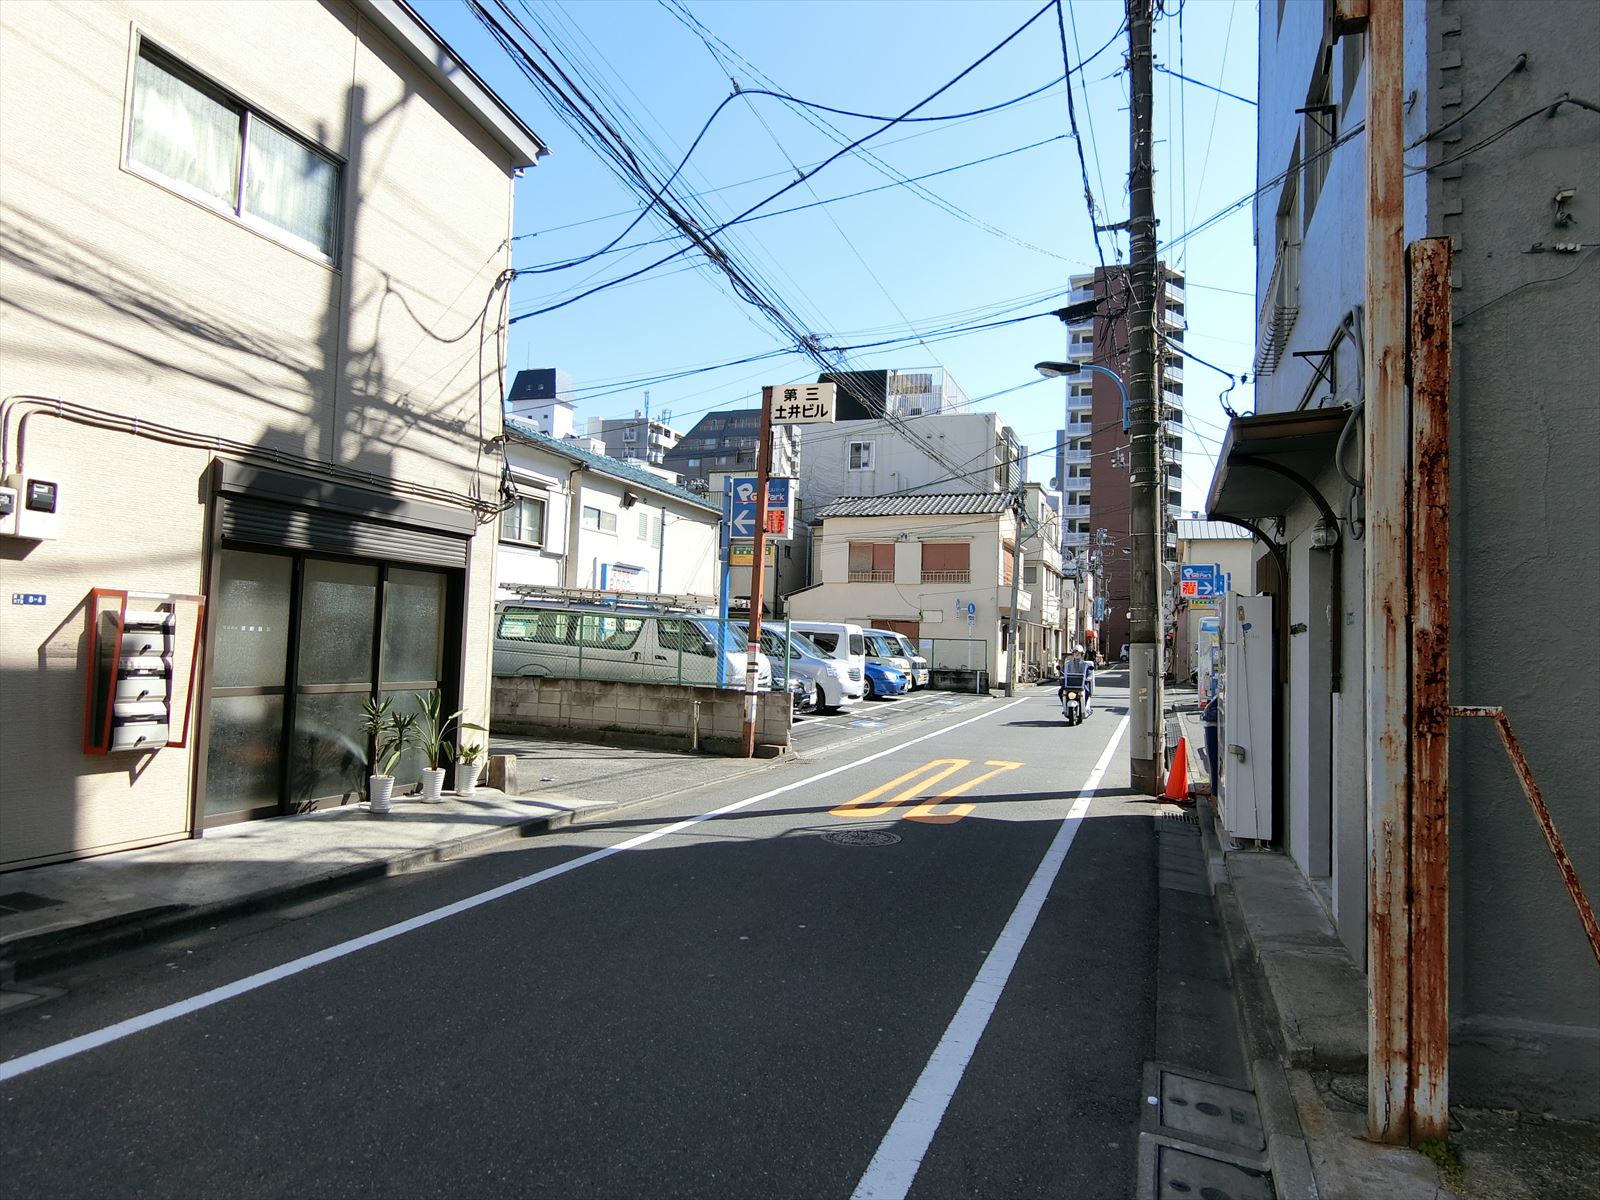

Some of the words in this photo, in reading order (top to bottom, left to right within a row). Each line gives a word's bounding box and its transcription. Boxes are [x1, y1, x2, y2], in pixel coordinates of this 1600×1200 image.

[784, 388, 819, 402] 第三
[775, 404, 828, 419] 土井ビル
